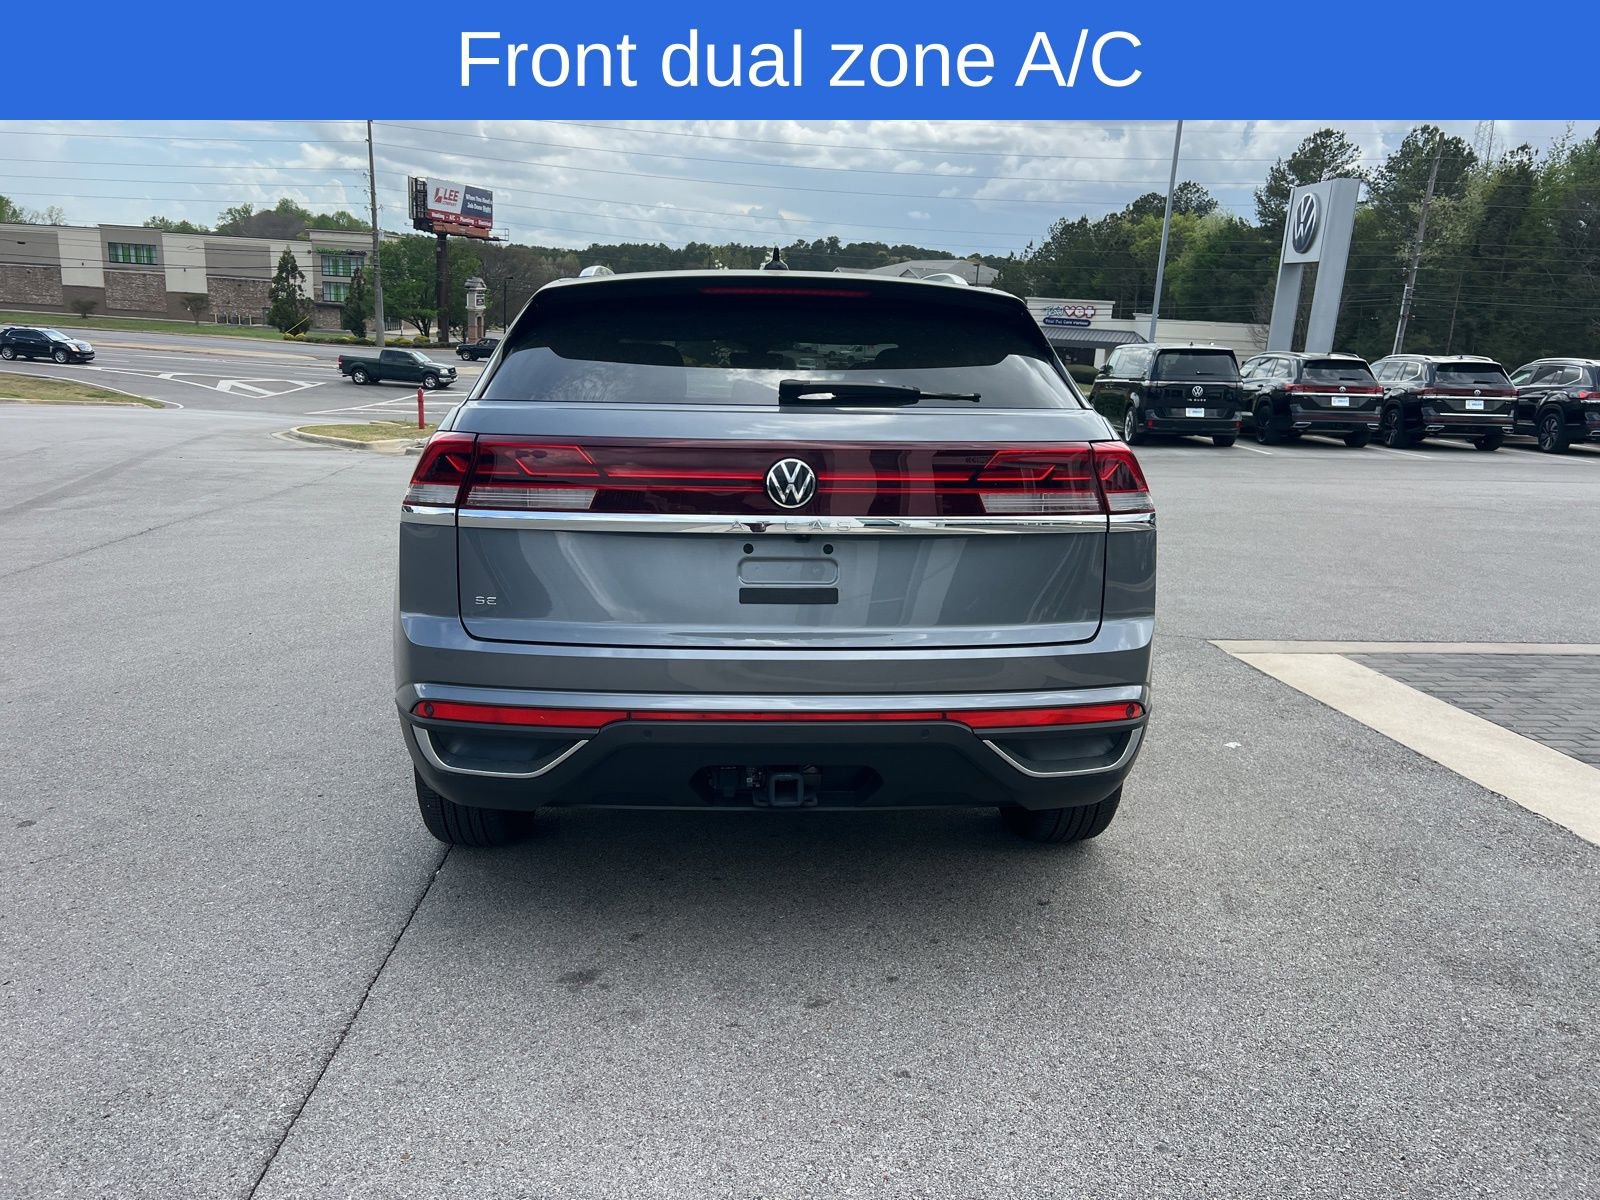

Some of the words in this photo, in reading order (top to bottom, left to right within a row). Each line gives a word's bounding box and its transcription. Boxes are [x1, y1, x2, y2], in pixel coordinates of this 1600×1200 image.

[443, 188, 459, 202] LEE
[730, 519, 852, 532] ATLAS
[475, 595, 497, 605] SE
